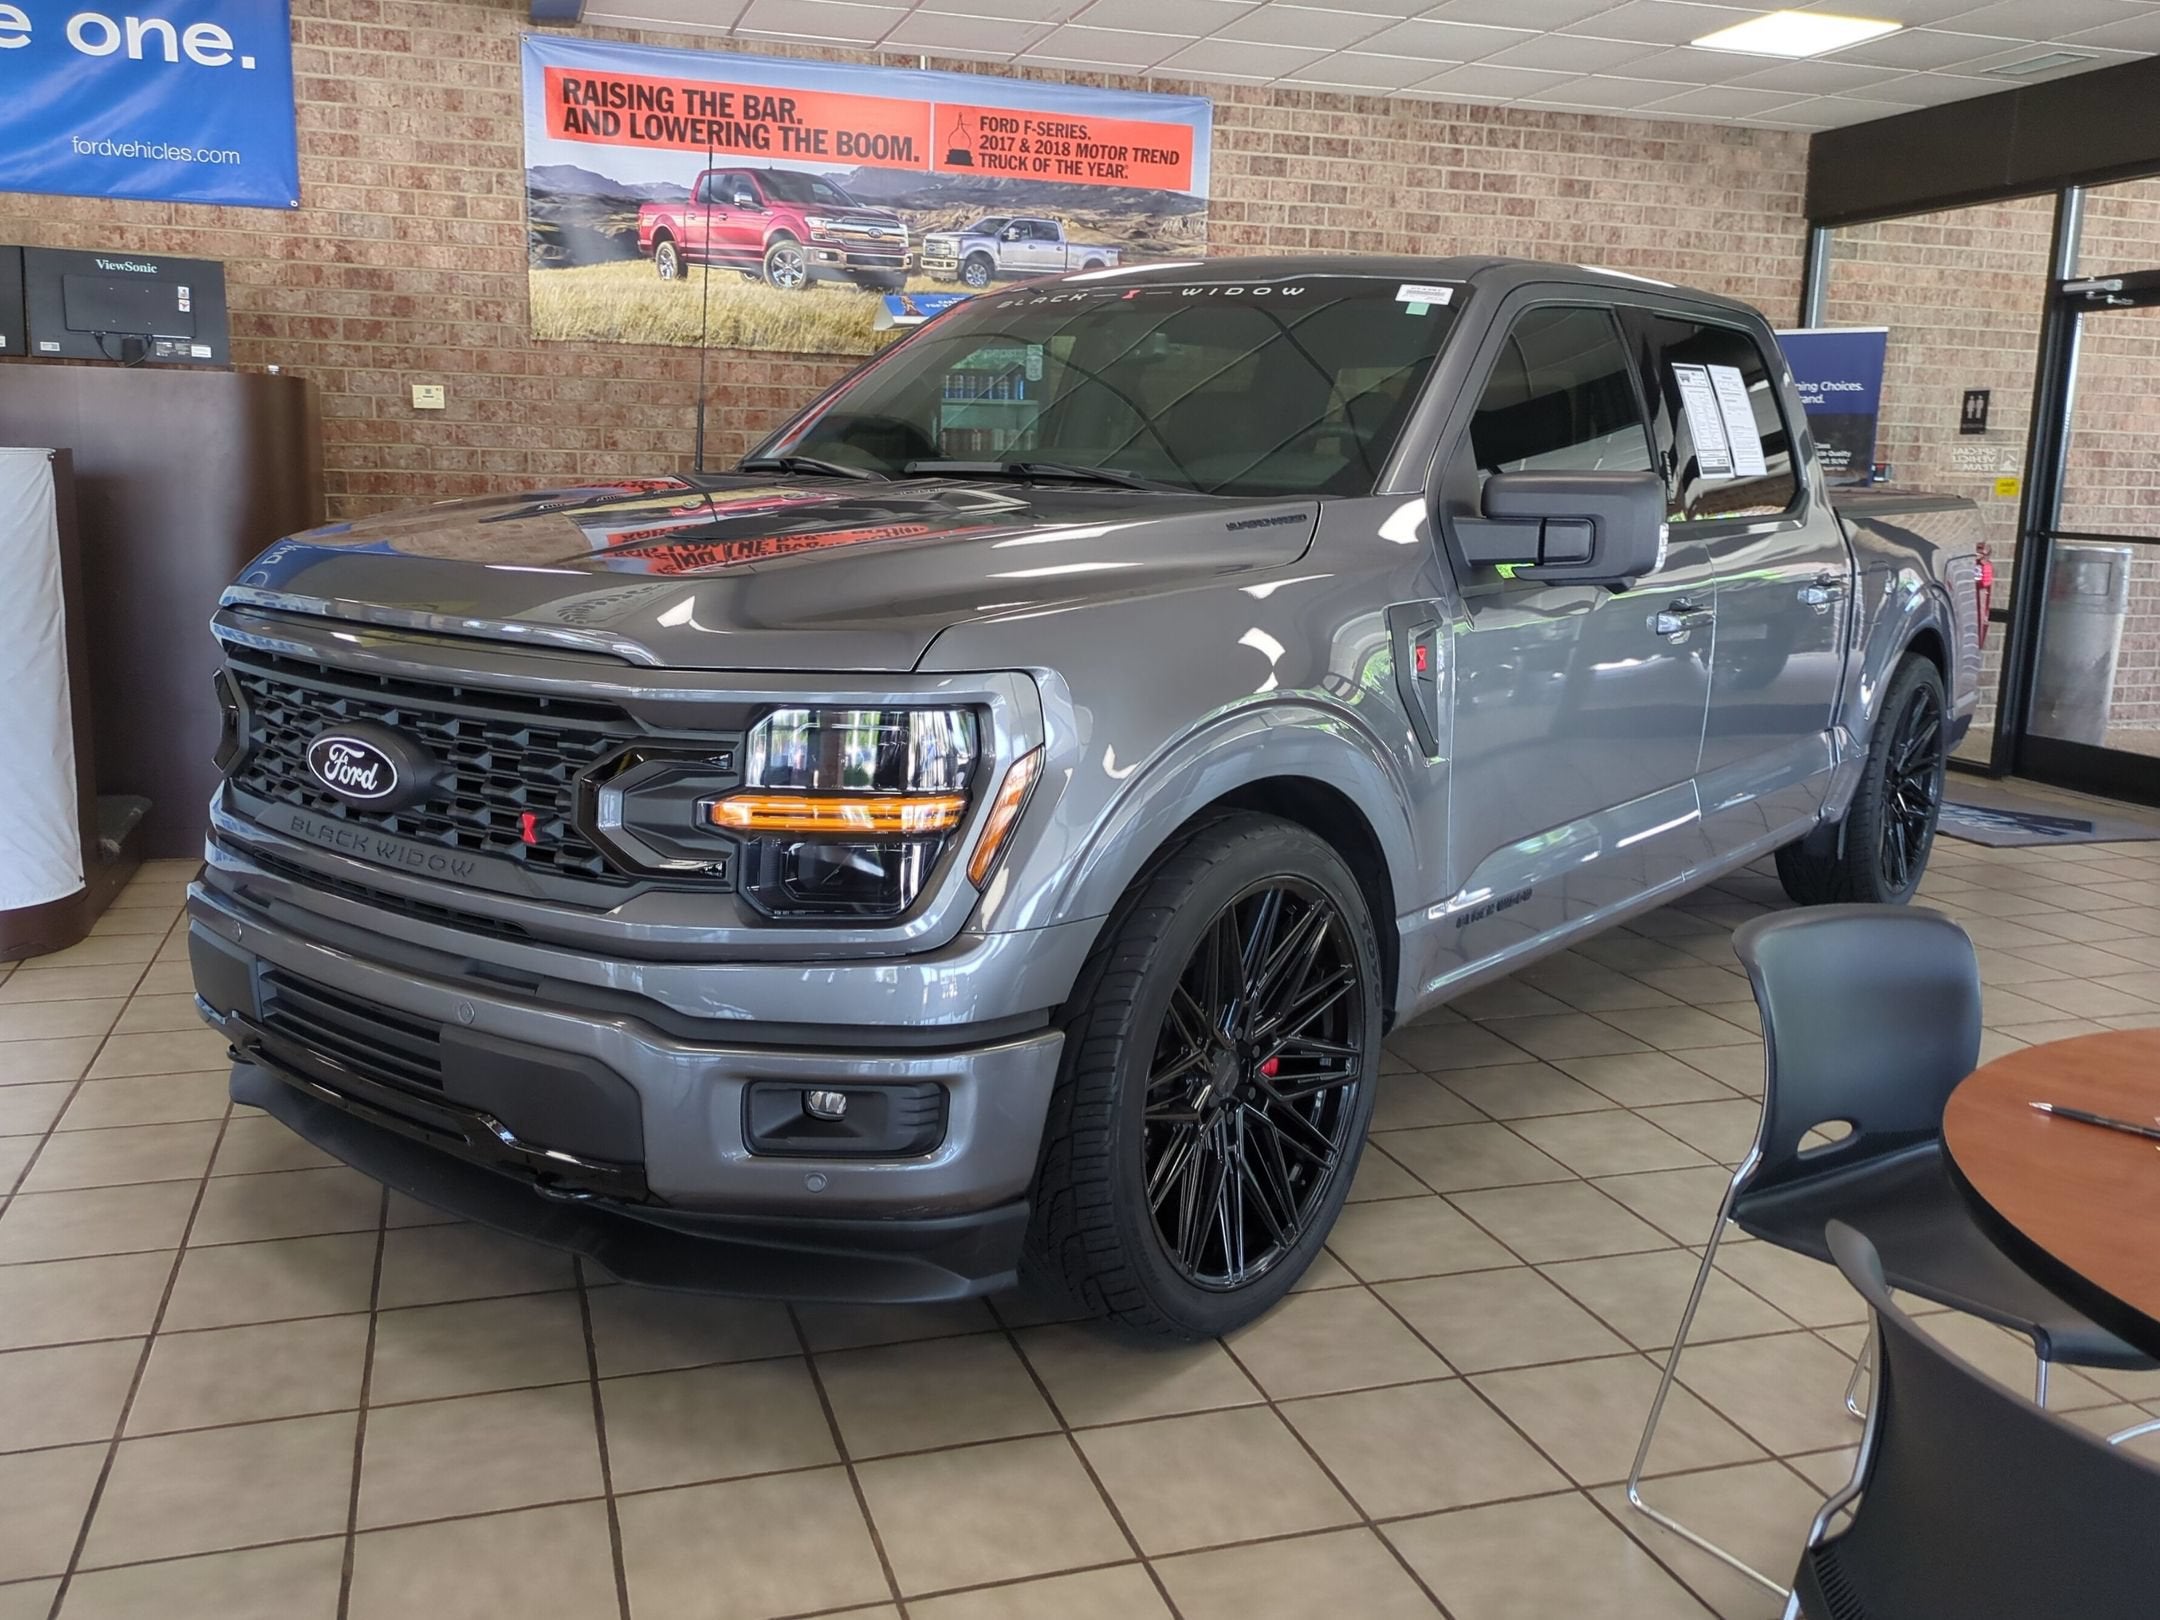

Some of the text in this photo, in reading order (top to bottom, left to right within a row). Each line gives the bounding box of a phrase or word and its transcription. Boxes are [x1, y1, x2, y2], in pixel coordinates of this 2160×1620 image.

[66, 12, 256, 69] one.
[562, 77, 804, 125] RAISING THE BAR.
[563, 106, 920, 163] AND LOWERING THE BOOM.
[979, 115, 1092, 141] FORD F-SERIES.
[72, 136, 241, 165] fordvehicles.com
[978, 152, 1028, 172] TRUCK
[1032, 156, 1052, 174] OF
[1055, 158, 1084, 176] THE
[979, 134, 1180, 166] 2017 & 2018 MOTOR TREND
[95, 258, 159, 274] ViewSonic
[996, 286, 1306, 309] BLACK WIDOW
[324, 743, 380, 791] Ford
[290, 815, 475, 878] BLACK WIDOW
